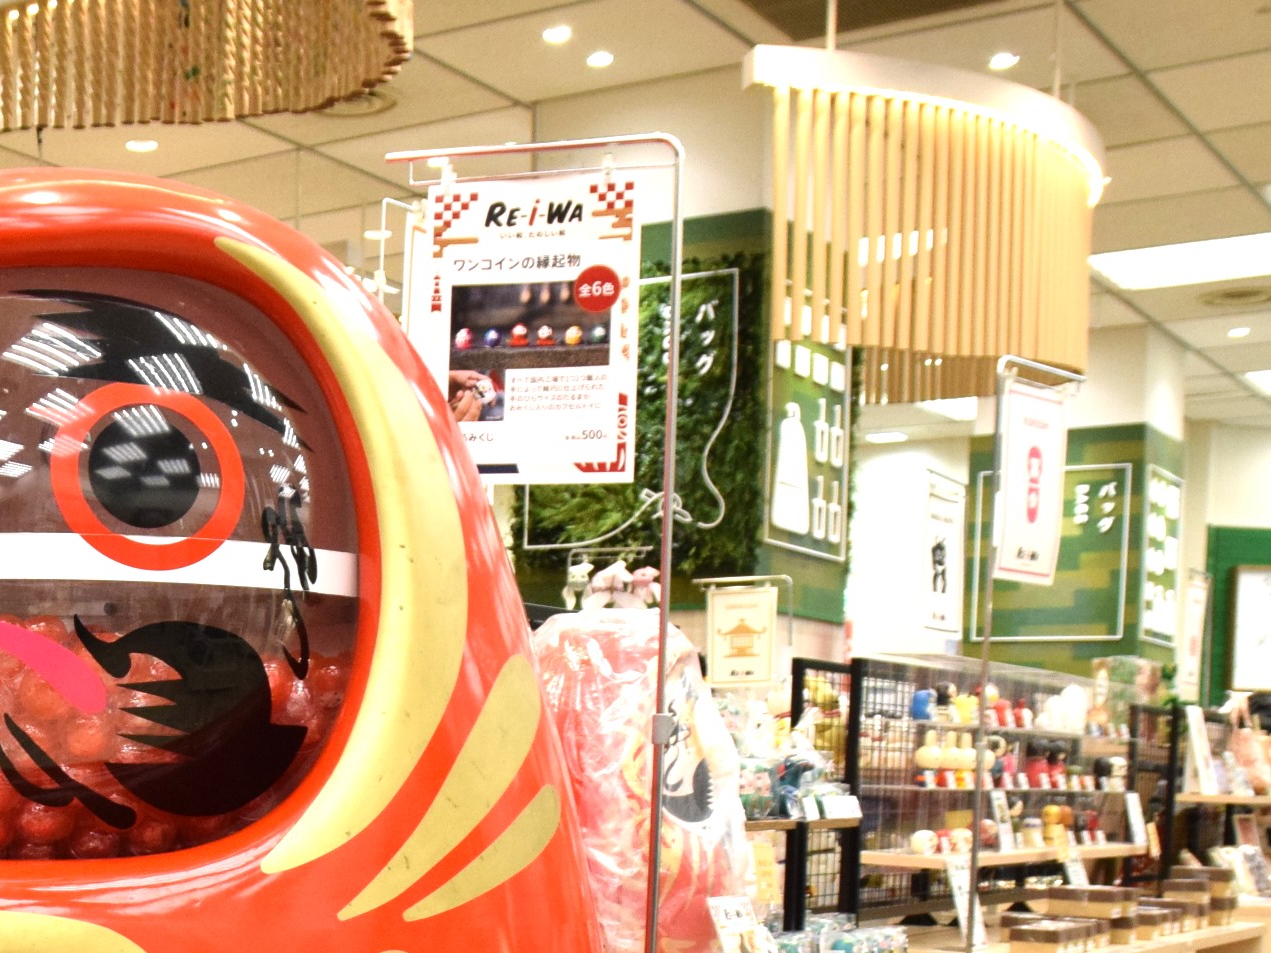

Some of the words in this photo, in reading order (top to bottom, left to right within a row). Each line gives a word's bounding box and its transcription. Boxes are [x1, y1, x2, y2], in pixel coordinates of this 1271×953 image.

[454, 253, 581, 272] ワンコインの縁起物
[579, 281, 615, 297] 全6色
[695, 300, 719, 376] バッグ
